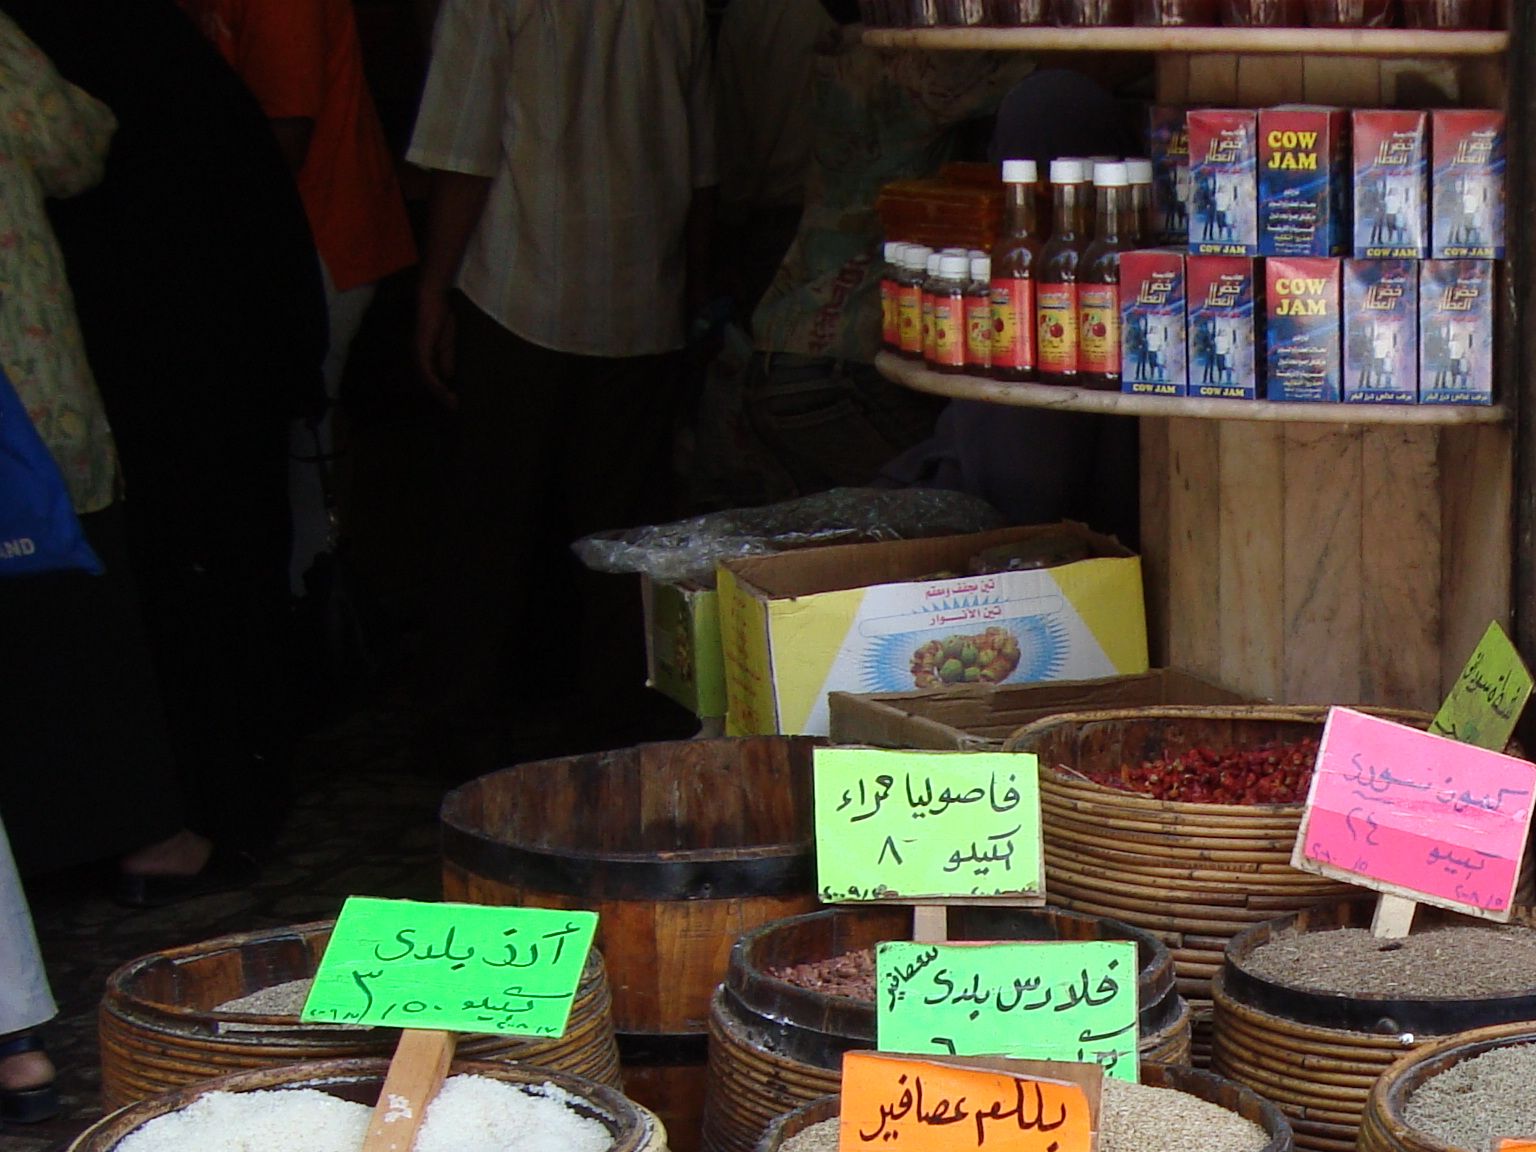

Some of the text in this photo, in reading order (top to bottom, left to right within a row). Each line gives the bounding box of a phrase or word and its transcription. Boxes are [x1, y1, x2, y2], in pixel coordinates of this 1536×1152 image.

[1267, 131, 1317, 148] COW
[1267, 152, 1317, 169] JAM
[1199, 244, 1246, 254] COW JAM
[1366, 248, 1417, 257] COW JAM
[1444, 248, 1495, 257] COW JAM
[1275, 278, 1326, 295] COW
[1275, 299, 1327, 315] JAM
[1132, 384, 1176, 394] COW JAM
[1200, 386, 1245, 397] COW JAM
[905, 770, 1021, 819] فاصوليا
[859, 1074, 968, 1142] عصافير
